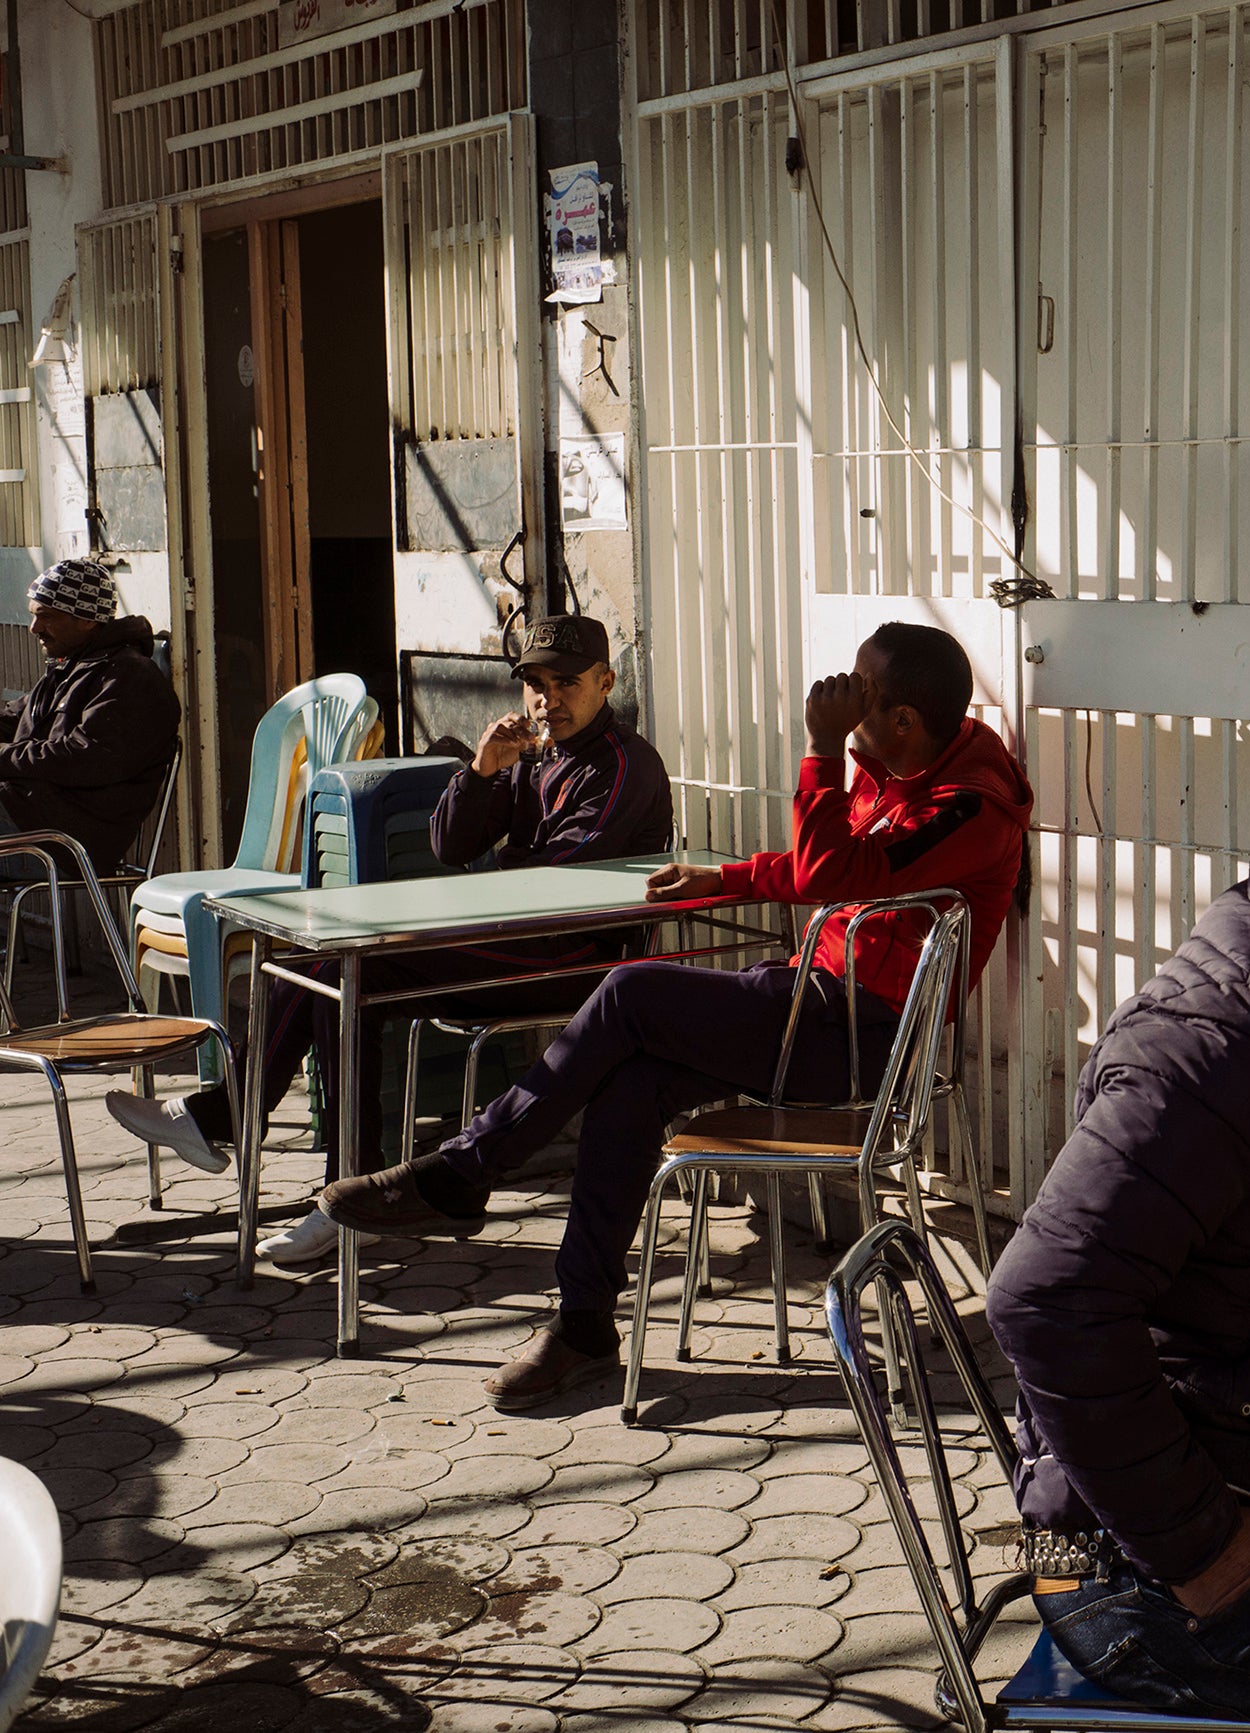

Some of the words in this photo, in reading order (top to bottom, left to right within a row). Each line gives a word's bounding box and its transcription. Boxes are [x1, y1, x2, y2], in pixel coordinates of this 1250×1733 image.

[555, 203, 595, 225] عمرة
[67, 570, 83, 581] GA
[59, 586, 77, 597] GA
[81, 584, 98, 595] GA
[76, 602, 97, 611] GA
